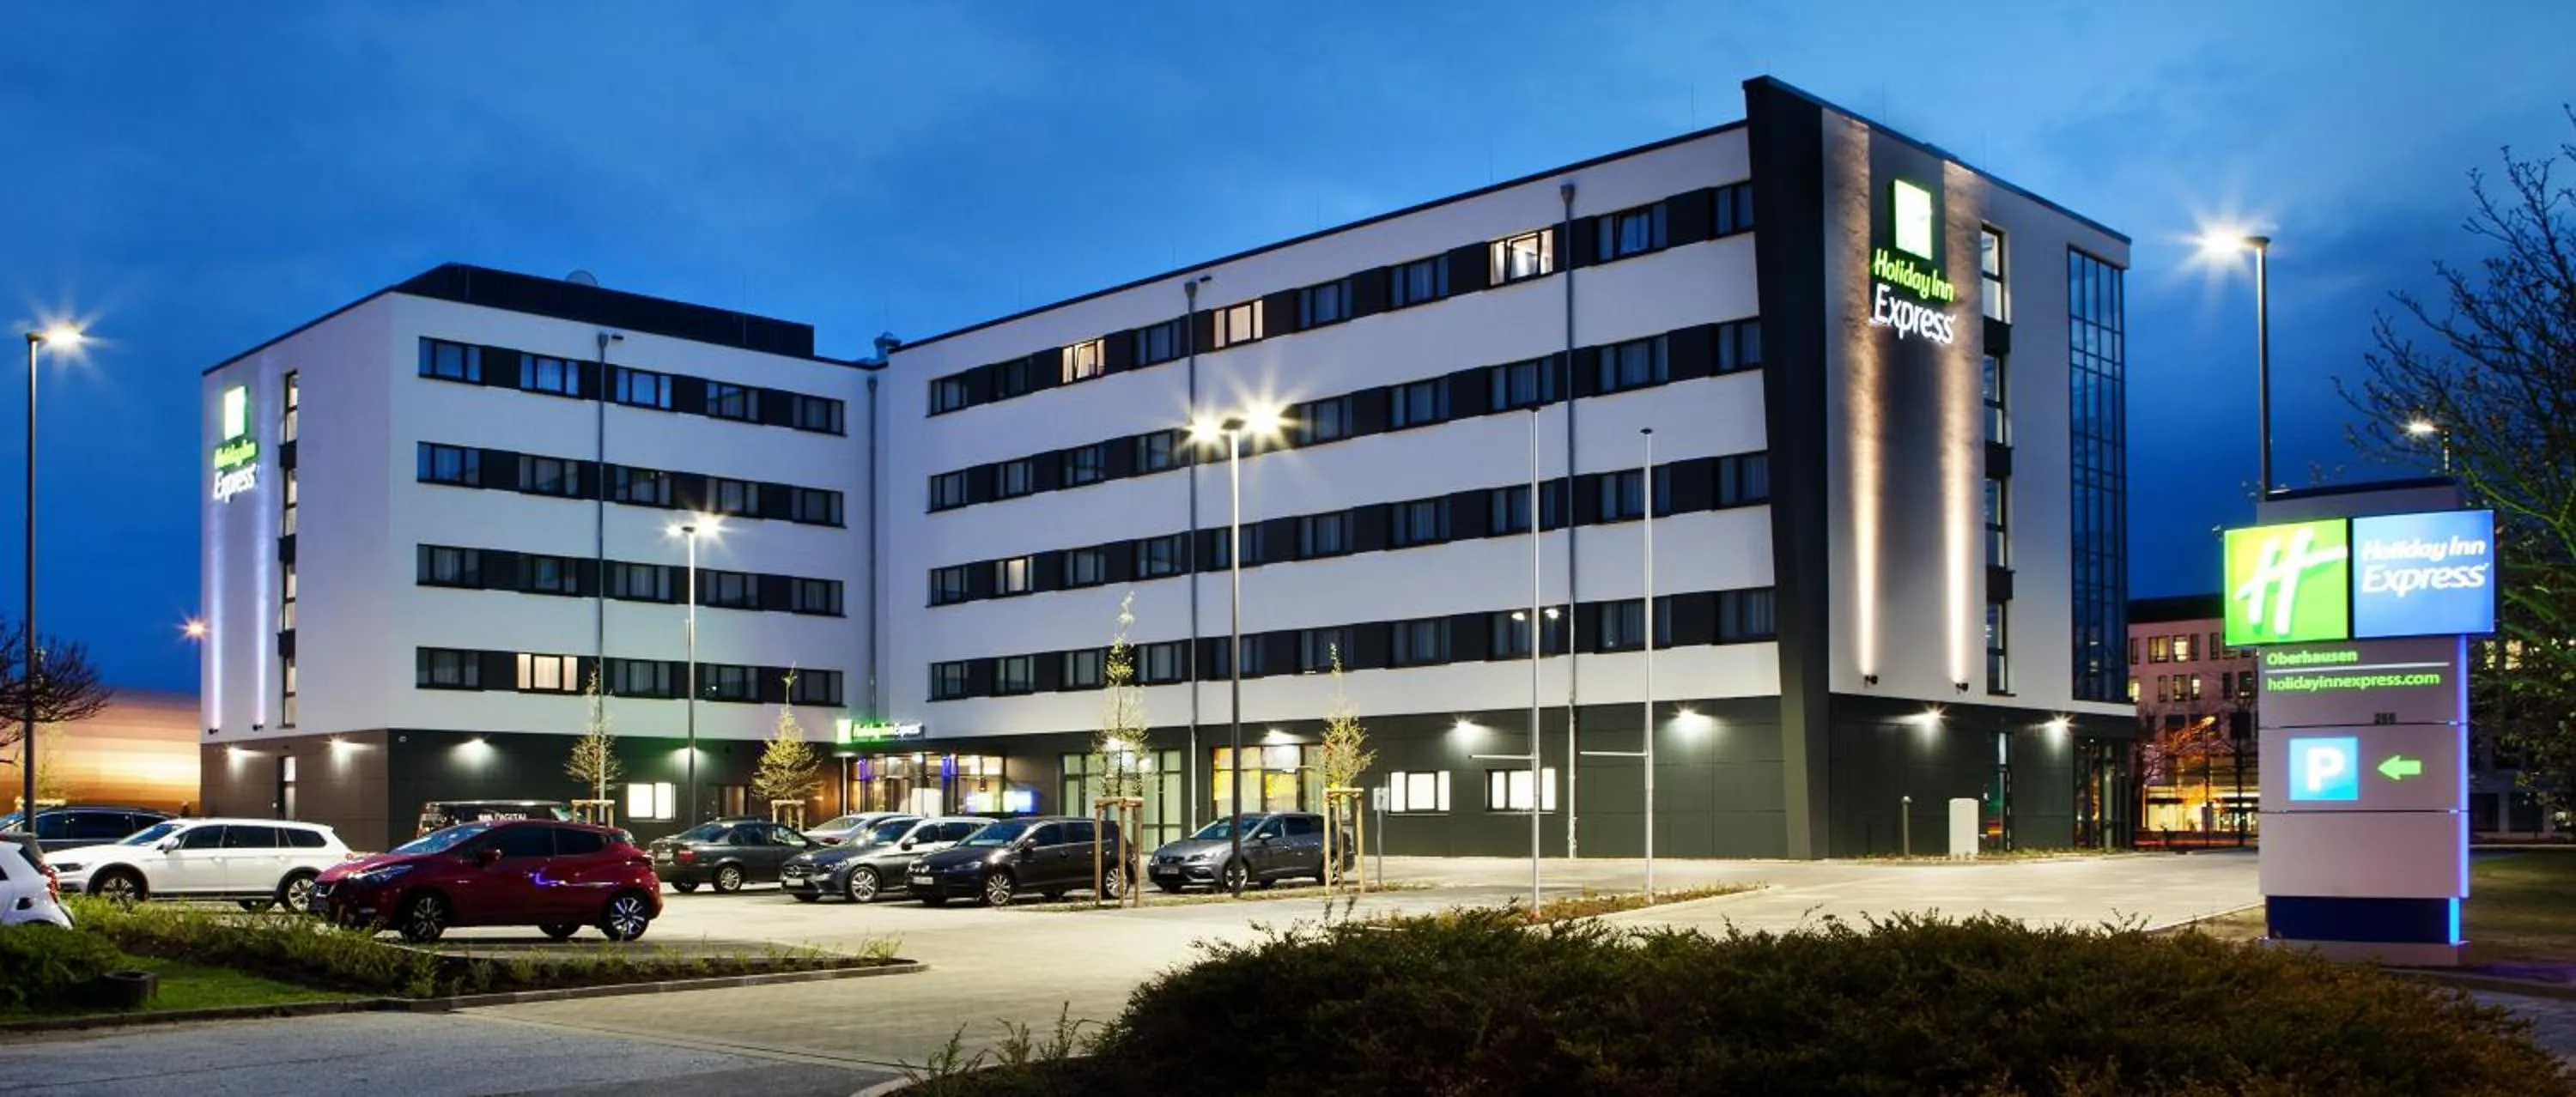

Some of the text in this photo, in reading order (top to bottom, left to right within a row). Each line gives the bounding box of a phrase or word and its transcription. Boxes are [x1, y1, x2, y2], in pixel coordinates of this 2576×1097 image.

[1874, 248, 1954, 303] Holiday Inn
[1872, 282, 1957, 345] Express
[2362, 535, 2487, 562] Holiday Inn
[2362, 563, 2489, 597] Express
[2266, 650, 2359, 665] Oberhausen
[2267, 673, 2440, 693] holidayinnexpress.com
[2306, 747, 2345, 791] P
